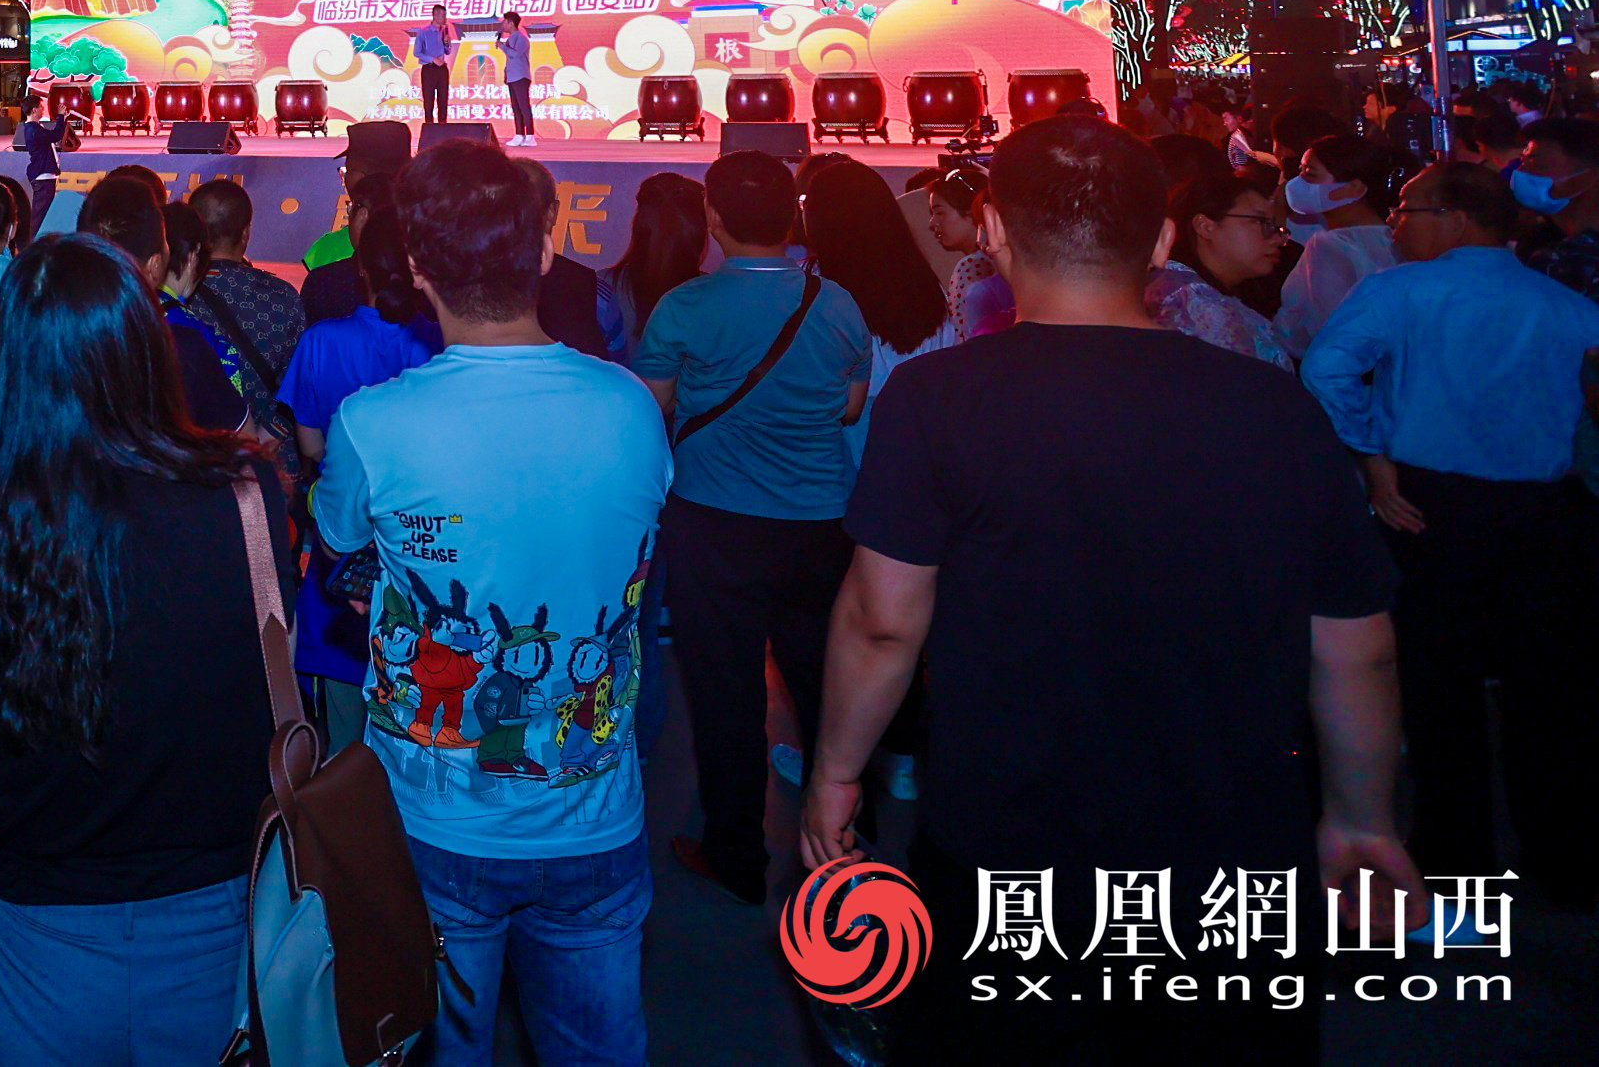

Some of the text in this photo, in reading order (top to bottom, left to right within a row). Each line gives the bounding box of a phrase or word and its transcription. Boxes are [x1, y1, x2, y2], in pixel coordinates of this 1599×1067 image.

[714, 37, 744, 64] 根
[411, 531, 435, 547] UP
[401, 541, 458, 563] PLEASE
